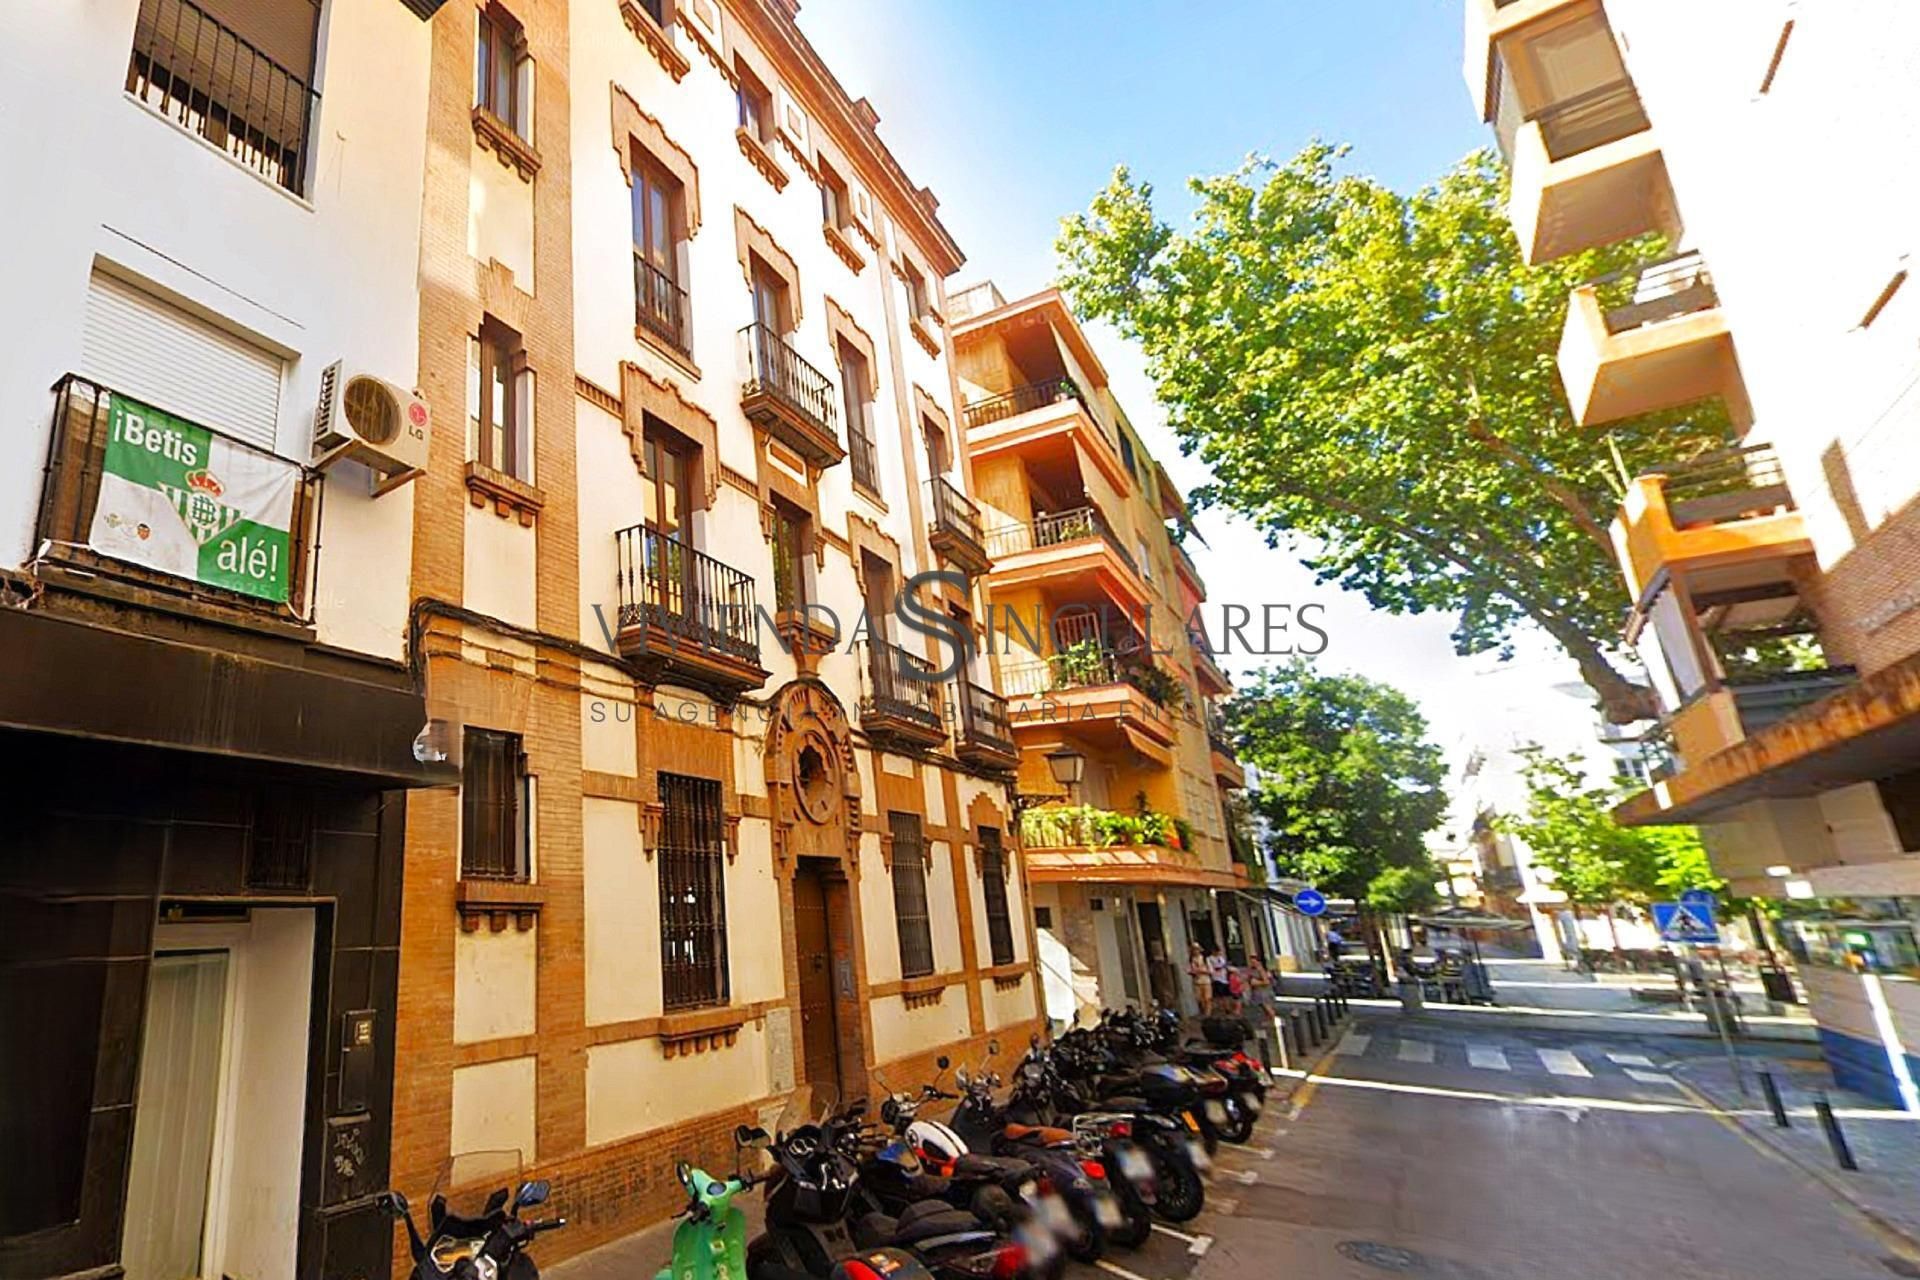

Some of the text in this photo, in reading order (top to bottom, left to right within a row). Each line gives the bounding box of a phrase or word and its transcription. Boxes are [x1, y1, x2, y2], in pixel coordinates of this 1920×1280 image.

[114, 410, 198, 467] ¡Betis
[408, 424, 424, 441] LG
[217, 534, 279, 582] alé!
